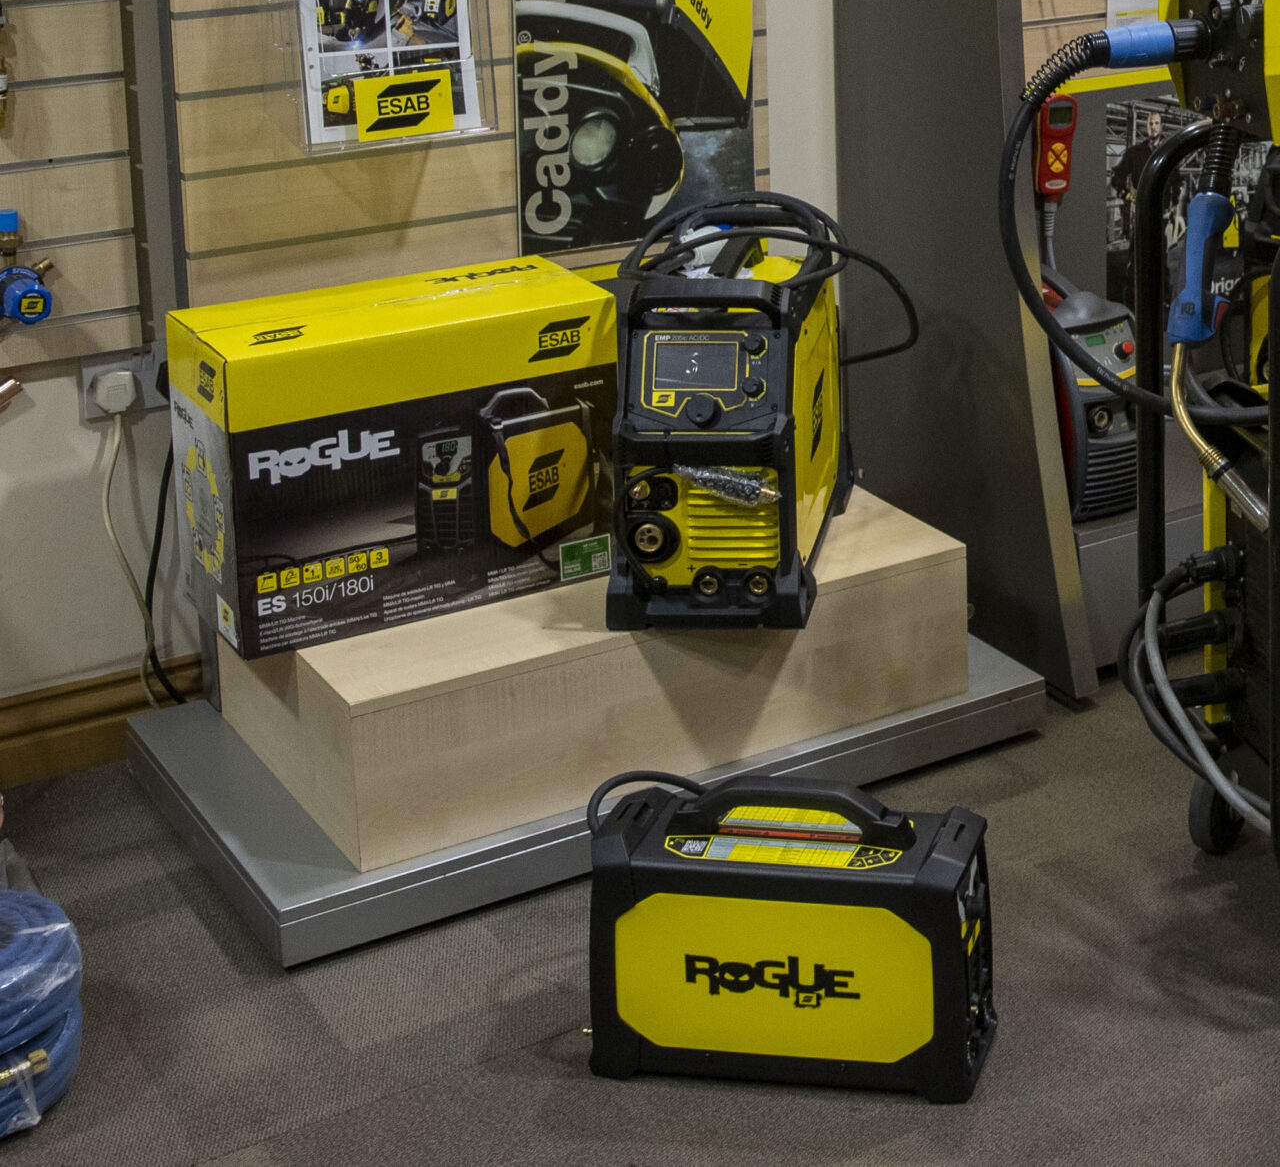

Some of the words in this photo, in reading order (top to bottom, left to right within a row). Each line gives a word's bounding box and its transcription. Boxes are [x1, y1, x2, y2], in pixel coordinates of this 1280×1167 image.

[376, 94, 431, 117] ESAB
[523, 40, 579, 235] Caddy
[538, 329, 582, 350] ESAB
[248, 429, 401, 486] ROGUE
[528, 467, 561, 495] ESAB
[376, 551, 383, 561] 3
[310, 569, 315, 578] 1
[257, 595, 287, 617] ES
[292, 574, 375, 609] 150i/180i
[684, 952, 861, 1001] ROGUE
